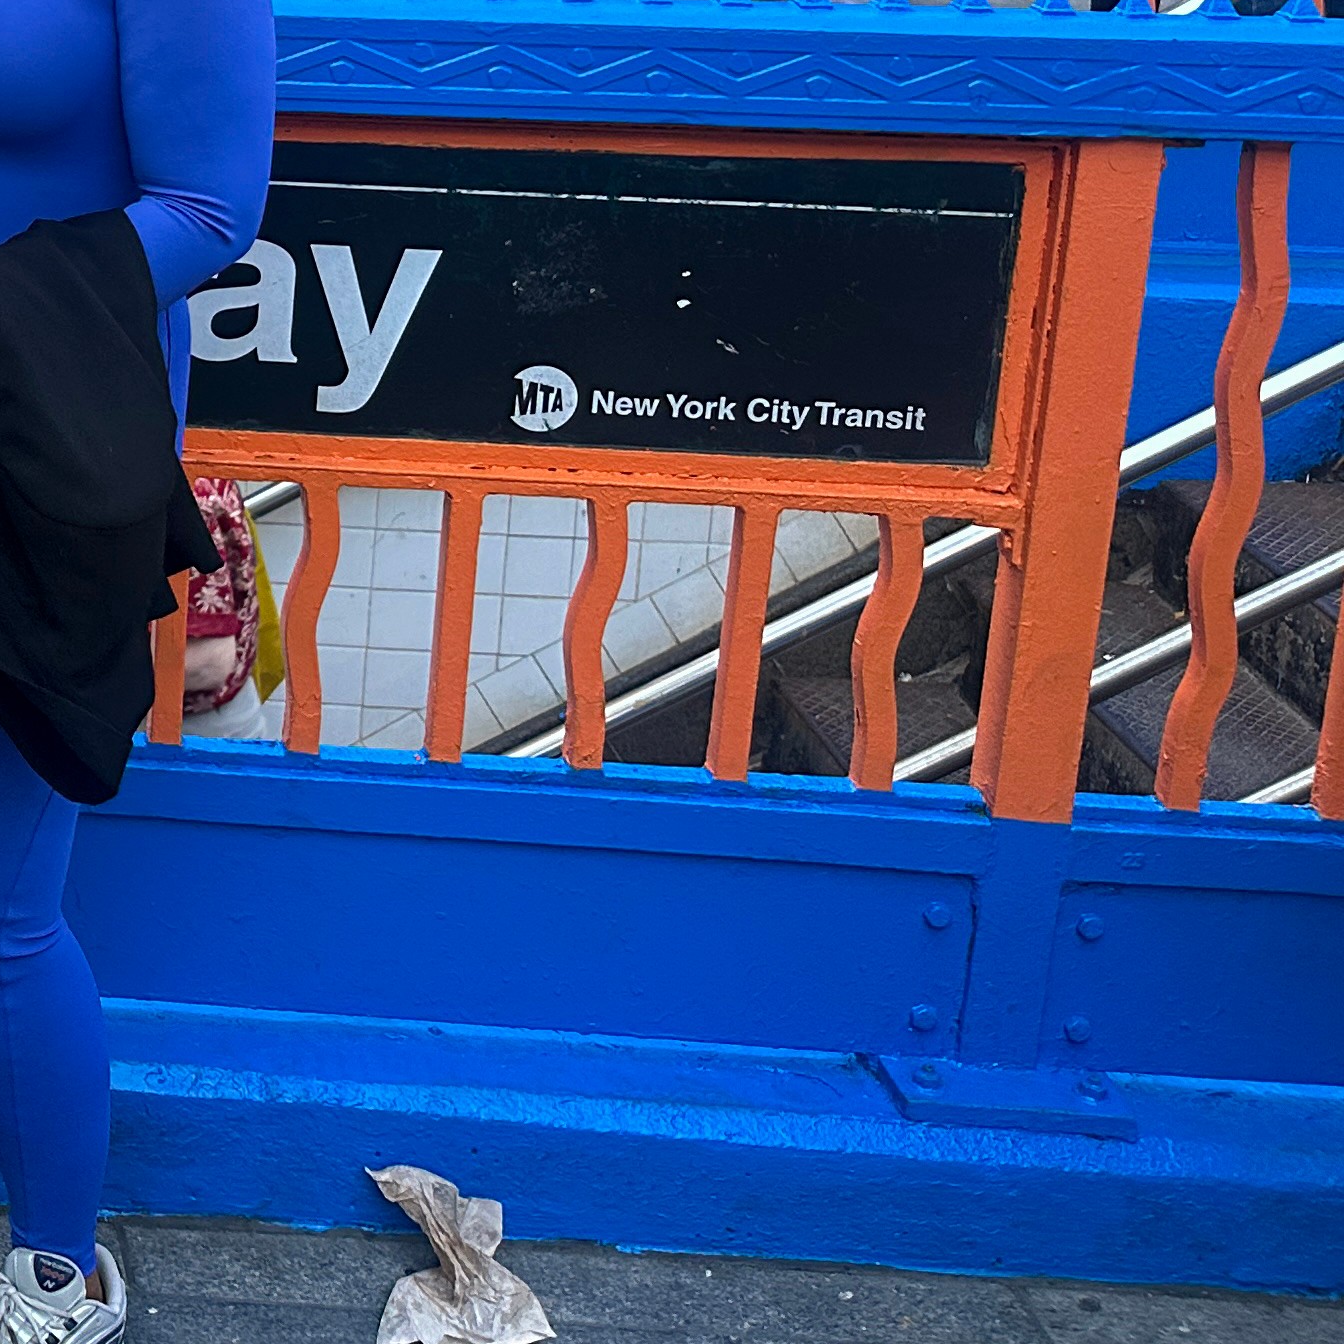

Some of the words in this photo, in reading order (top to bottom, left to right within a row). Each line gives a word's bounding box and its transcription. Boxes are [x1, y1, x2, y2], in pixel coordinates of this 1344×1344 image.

[510, 377, 564, 416] MTA
[591, 390, 660, 418] New
[666, 393, 737, 421] York
[746, 398, 810, 431] City
[814, 401, 927, 432] Transit
